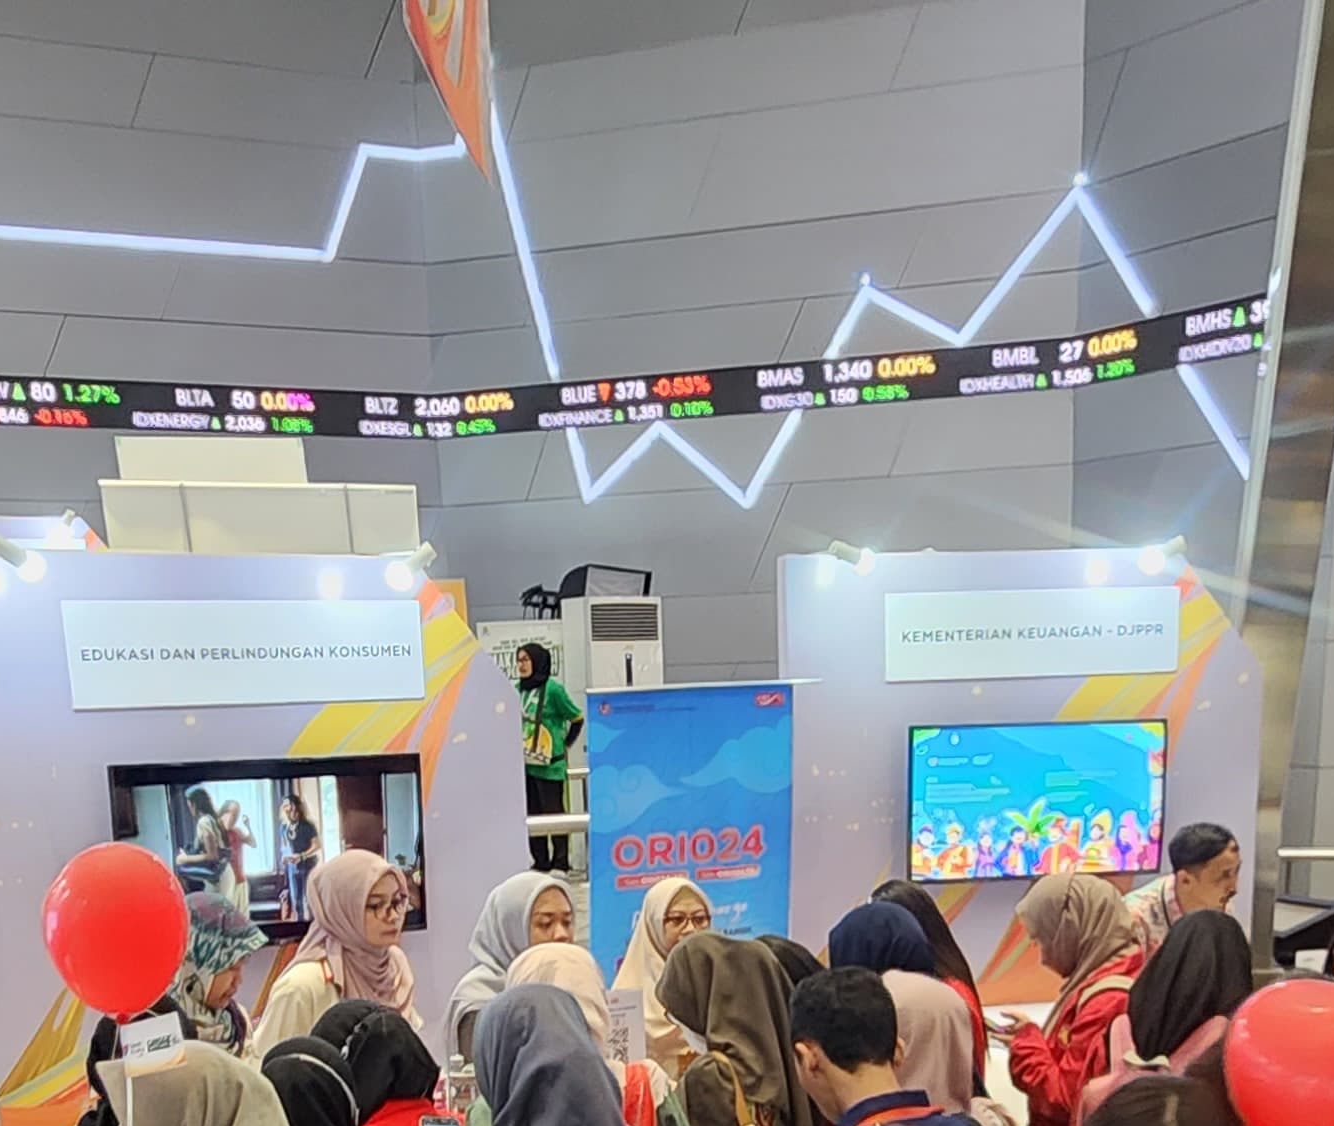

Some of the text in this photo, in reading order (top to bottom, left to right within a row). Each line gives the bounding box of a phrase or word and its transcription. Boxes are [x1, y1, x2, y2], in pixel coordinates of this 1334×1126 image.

[1185, 307, 1233, 337] BMHS
[991, 329, 1138, 369] BMBL 27 0.00%
[756, 366, 805, 388] BMAS
[877, 354, 936, 378] 0.00%
[29, 380, 57, 402] 80
[62, 382, 121, 404] 1.27%
[174, 387, 316, 412] BLTA 50 0.00%
[364, 396, 399, 416] BLTZ
[464, 392, 515, 413] 0.00%
[560, 385, 597, 405] BLUE
[614, 381, 647, 400] 378
[901, 628, 1012, 643] KEMENTERIAN
[1017, 625, 1103, 640] KEUANGAN
[1117, 623, 1164, 637] DJPPR
[80, 644, 412, 662] EDUKASI DAN PERLINDUNGAN KONSUMEN
